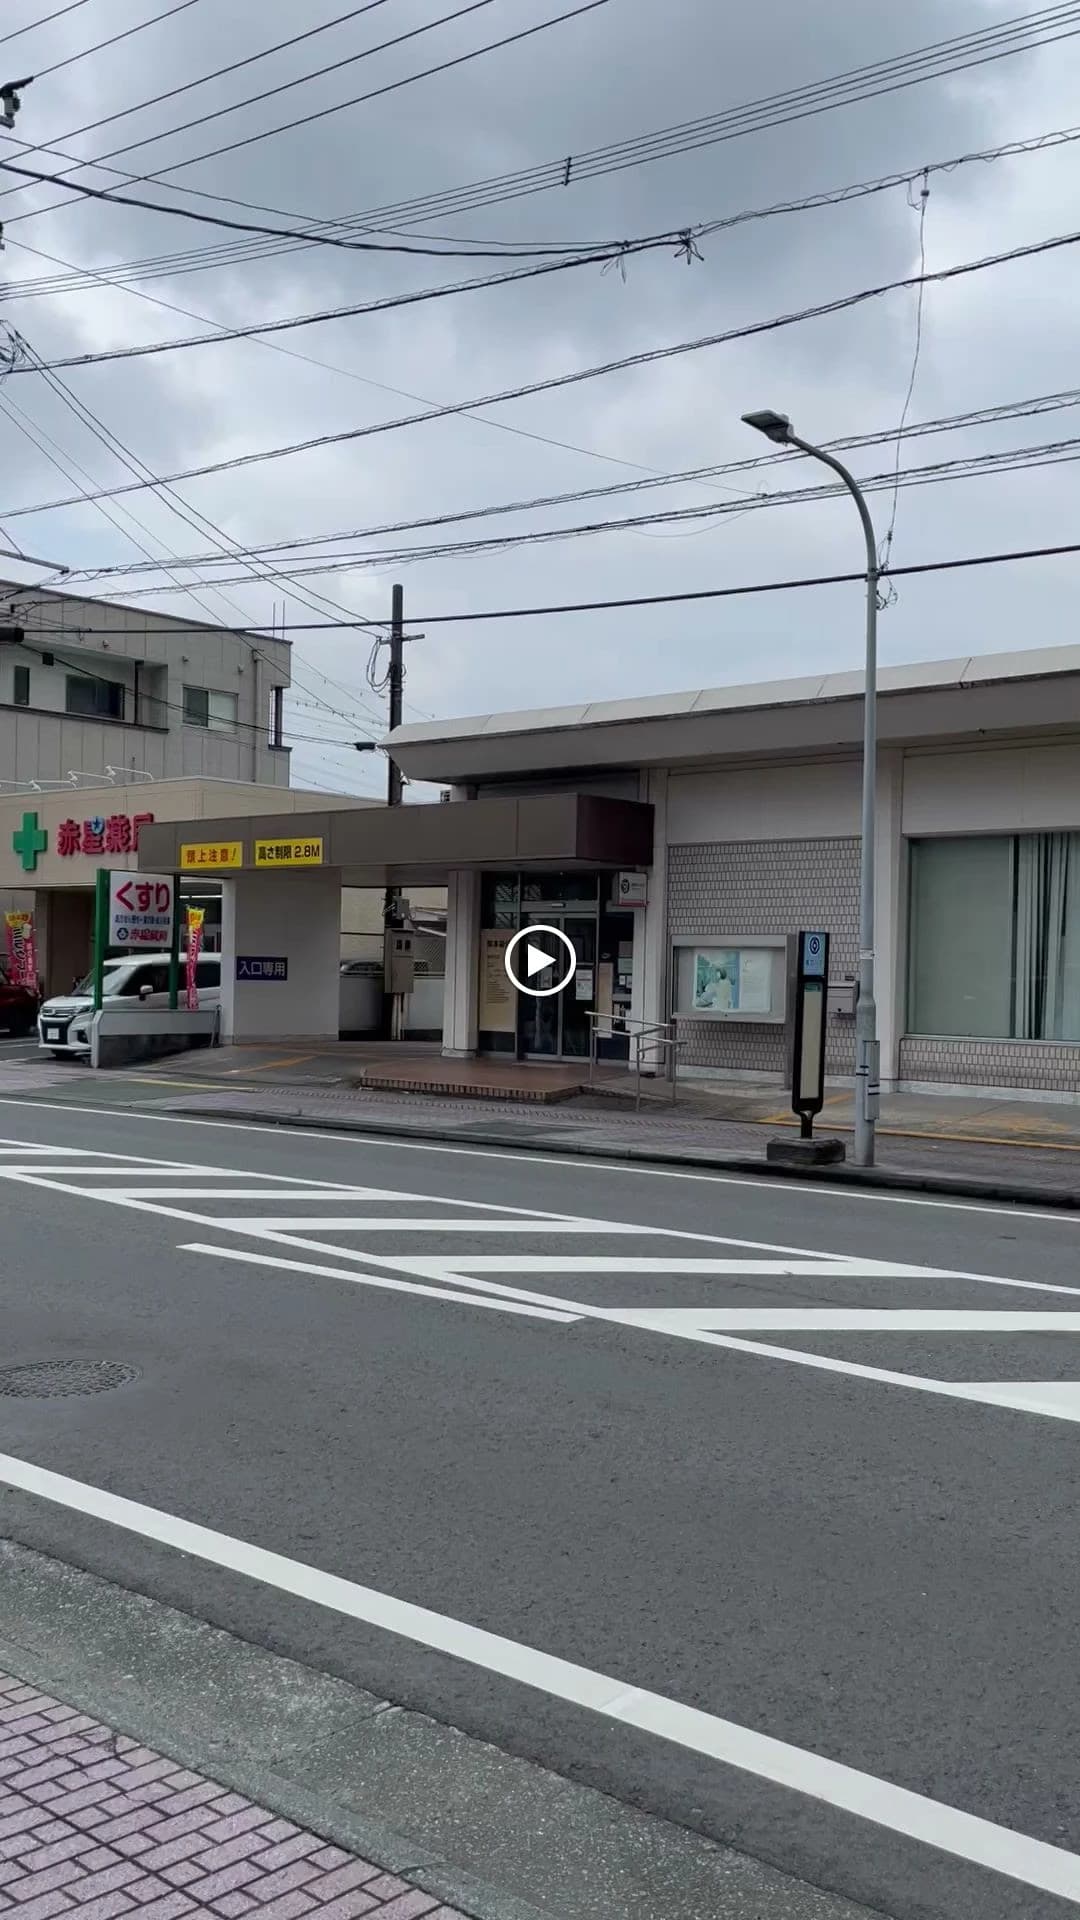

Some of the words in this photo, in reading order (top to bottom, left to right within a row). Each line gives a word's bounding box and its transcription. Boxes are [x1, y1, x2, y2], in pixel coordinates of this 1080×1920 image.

[115, 881, 170, 913] くすり
[239, 960, 285, 977] 入口専用
